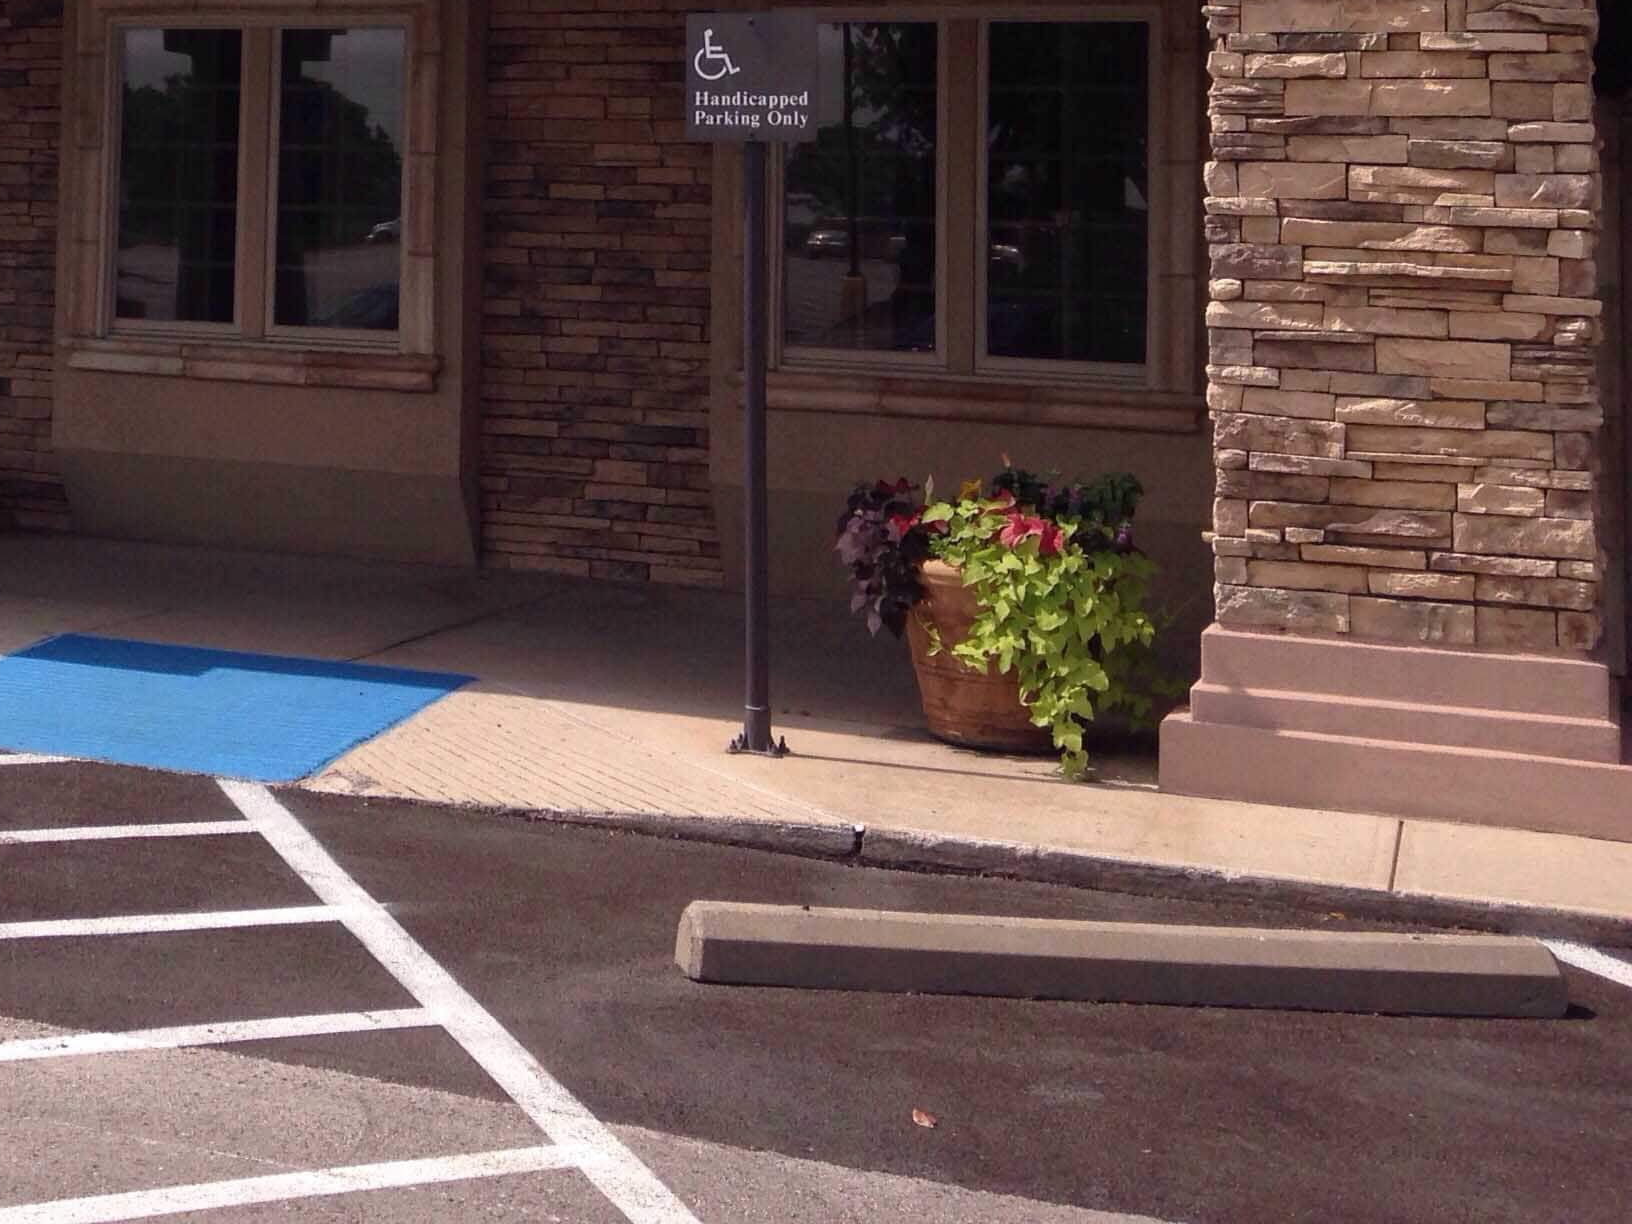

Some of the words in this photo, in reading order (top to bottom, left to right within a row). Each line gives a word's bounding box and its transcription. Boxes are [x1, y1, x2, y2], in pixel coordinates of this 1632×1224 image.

[695, 90, 808, 109] Handicapped
[695, 110, 760, 128] Parking
[768, 110, 808, 128] Only
